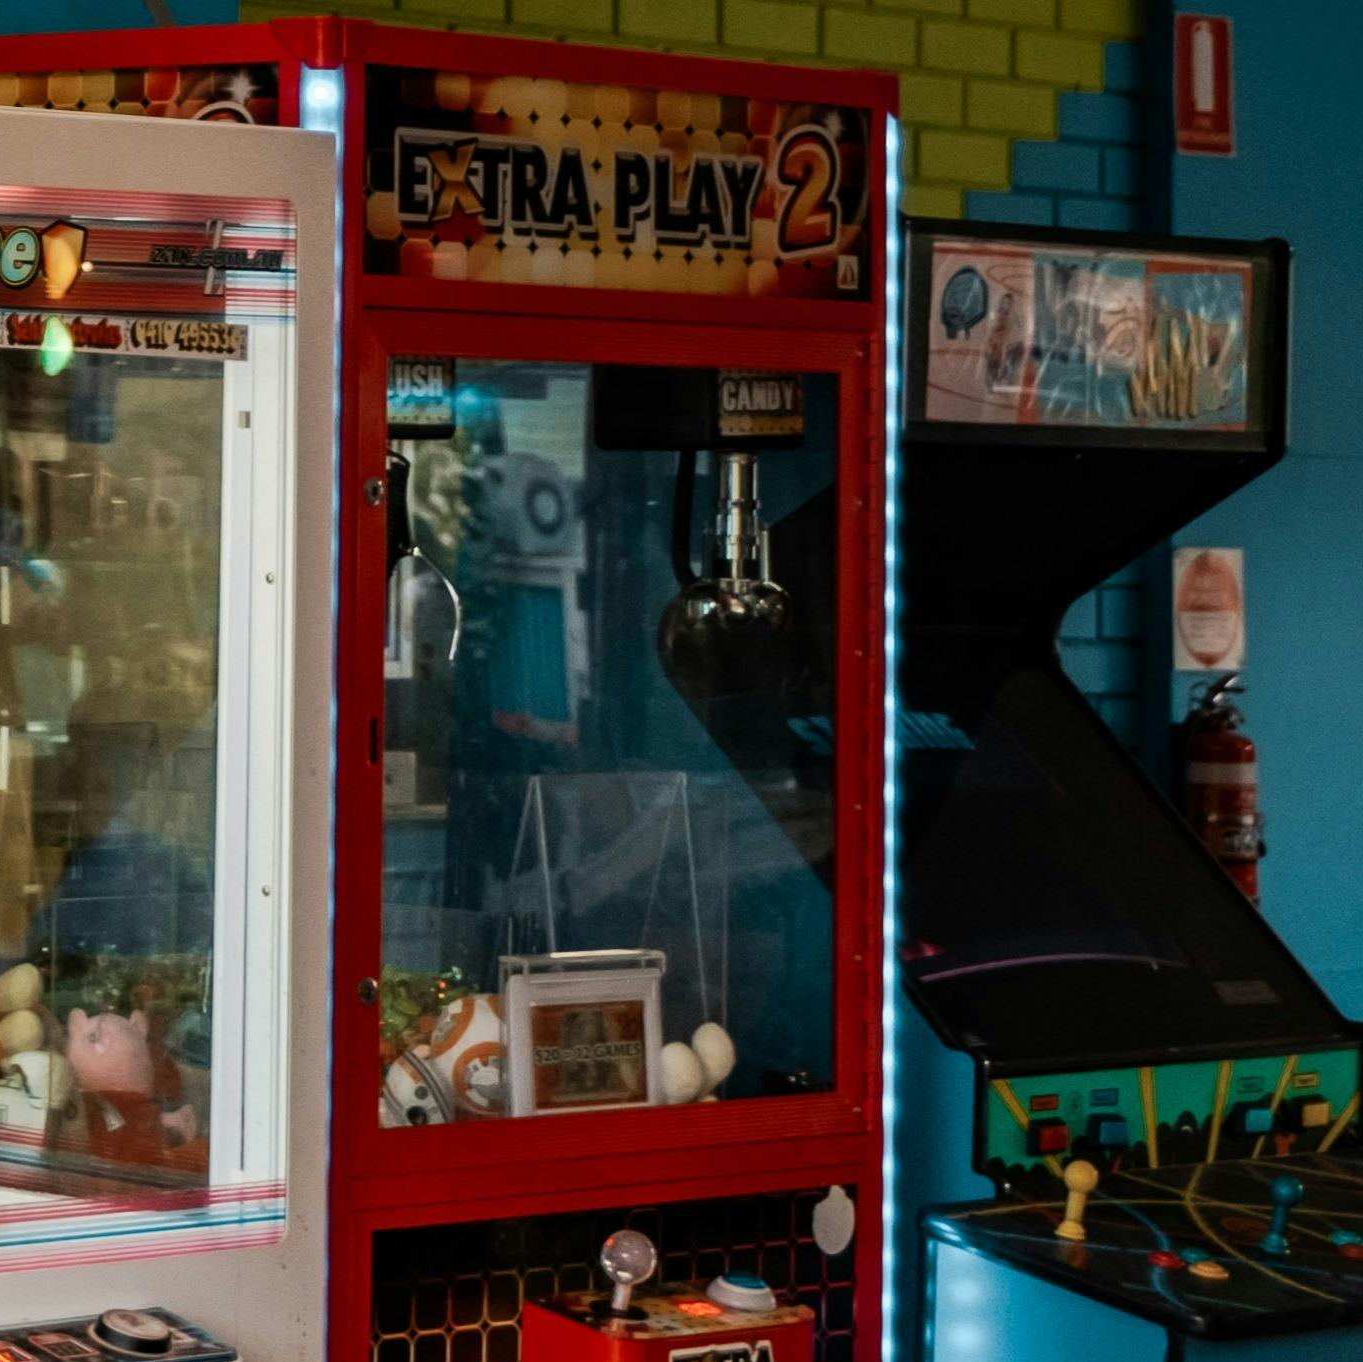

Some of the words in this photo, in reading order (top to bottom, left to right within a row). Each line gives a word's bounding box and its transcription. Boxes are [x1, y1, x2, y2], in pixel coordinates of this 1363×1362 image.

[394, 127, 598, 240] EXTRA
[612, 147, 763, 250] PLAY
[776, 124, 841, 259] 2
[387, 363, 443, 398] USH
[722, 380, 794, 411] CANDY
[594, 1041, 642, 1059] GAMES
